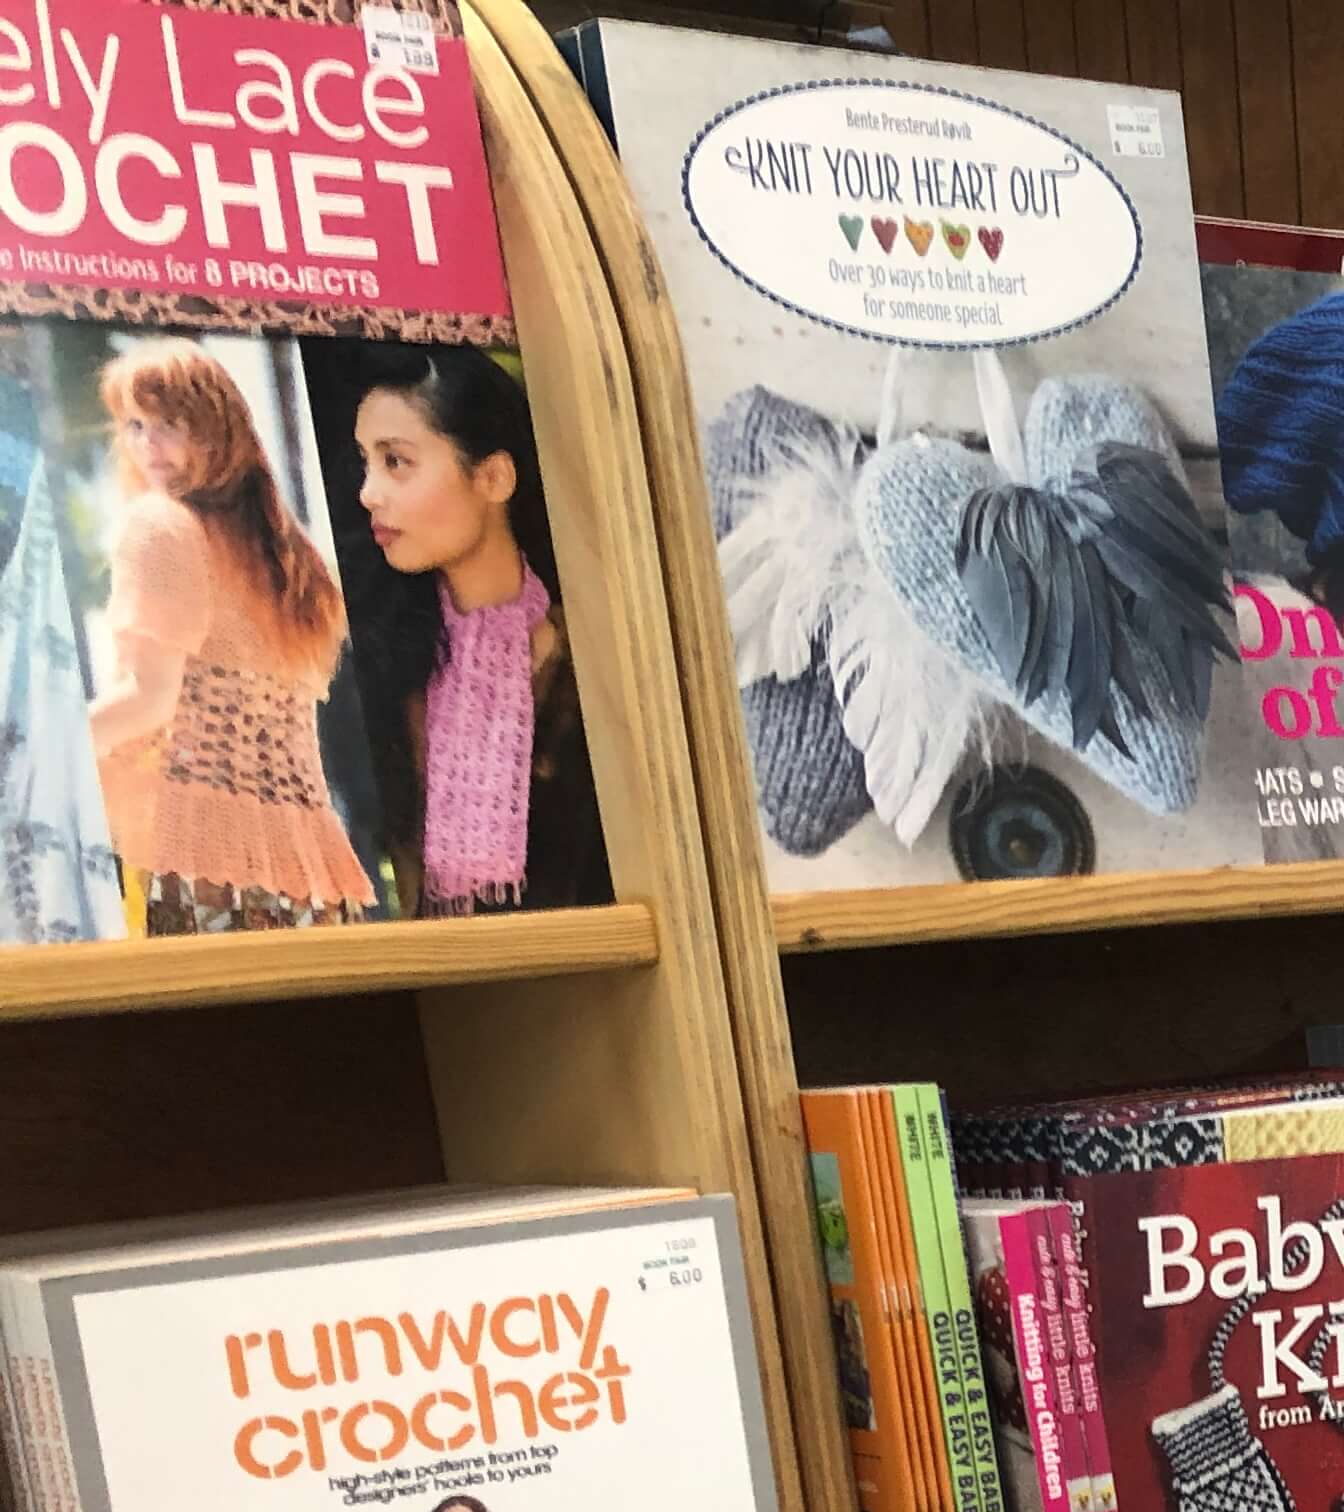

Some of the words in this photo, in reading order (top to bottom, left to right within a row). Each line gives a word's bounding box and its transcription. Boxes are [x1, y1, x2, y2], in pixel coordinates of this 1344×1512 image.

[160, 14, 430, 149] Lace
[0, 120, 454, 267] OCHET
[725, 136, 813, 196] KNIT
[826, 150, 903, 203] YOUR
[912, 155, 998, 213] HEART
[1010, 154, 1079, 220] OUT
[19, 244, 160, 284] Instructions
[165, 258, 197, 285] for
[204, 259, 221, 288] 8
[229, 260, 379, 299] PROJECTS
[828, 257, 863, 284] Over
[865, 262, 886, 290] 30
[888, 267, 926, 296] ways
[928, 267, 944, 290] to
[947, 264, 975, 291] knit
[976, 274, 987, 293] a
[987, 270, 1026, 298] heart
[864, 292, 885, 318] for
[888, 297, 953, 324] someone
[955, 298, 1002, 327] special
[1261, 668, 1344, 741] of
[1256, 798, 1296, 828] LEG
[224, 1286, 612, 1399] runway
[933, 1312, 957, 1385] QUICK
[1017, 1293, 1044, 1384] Knitting
[233, 1345, 633, 1480] crochet
[945, 1393, 963, 1406] &
[1033, 1385, 1050, 1411] for
[1259, 1403, 1313, 1431] from
[327, 1461, 412, 1494] high-style
[415, 1450, 487, 1480] patterns
[488, 1448, 529, 1469] from
[530, 1443, 560, 1468] top
[949, 1416, 973, 1471] EASY
[1034, 1411, 1063, 1500] Children
[342, 1478, 430, 1507] designers'
[433, 1471, 482, 1491] hooks
[485, 1468, 504, 1483] to
[507, 1461, 553, 1483] yours
